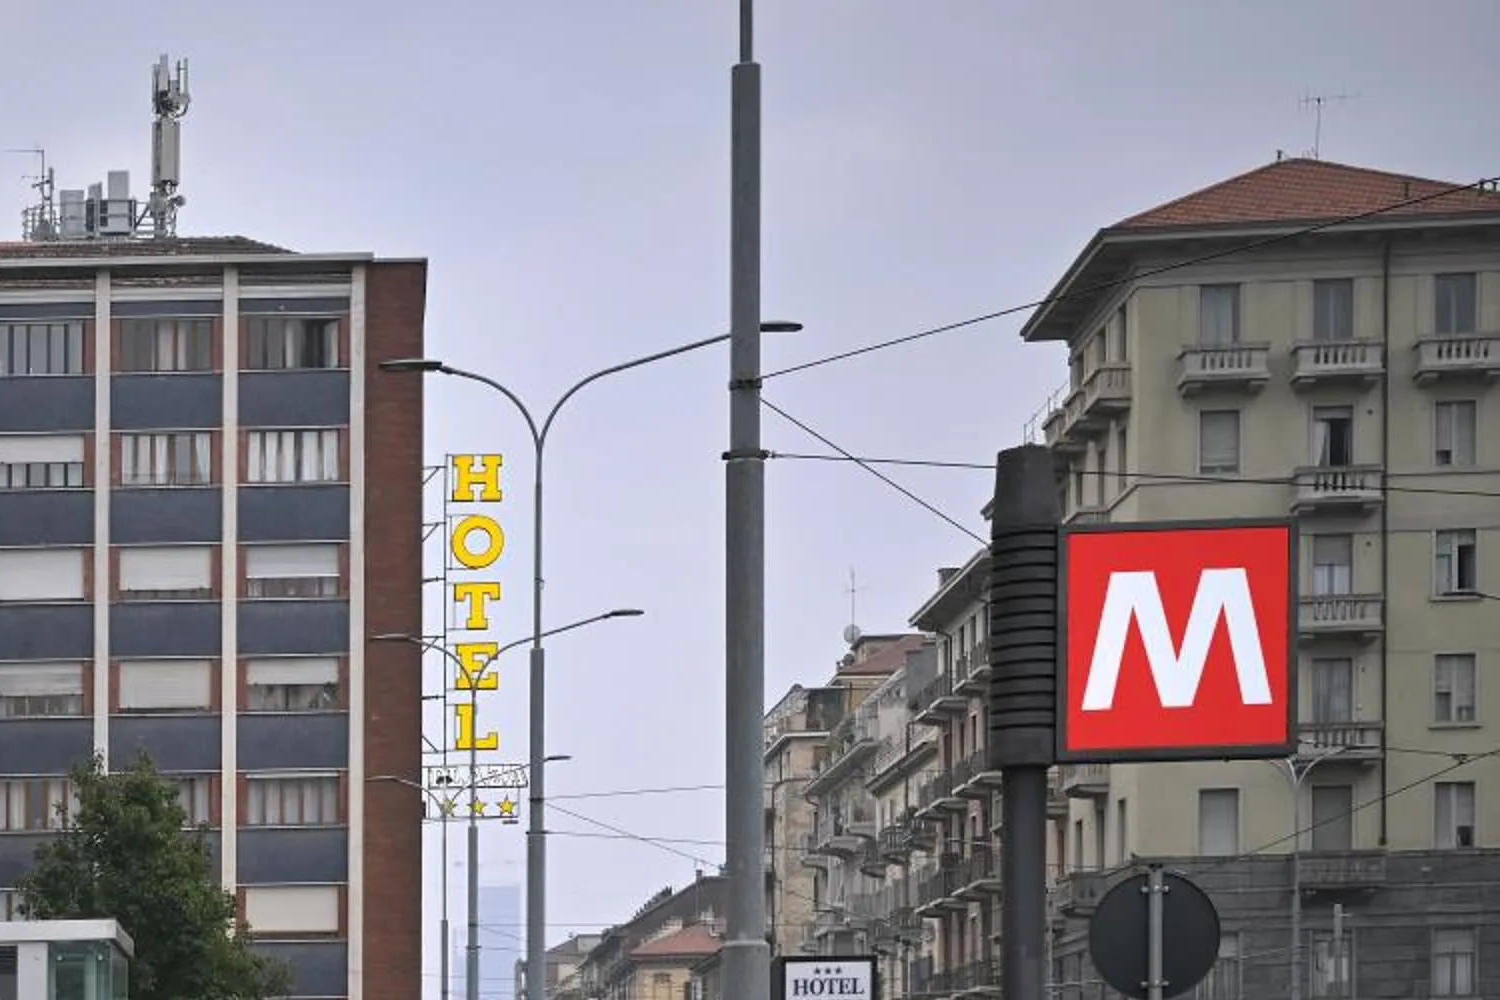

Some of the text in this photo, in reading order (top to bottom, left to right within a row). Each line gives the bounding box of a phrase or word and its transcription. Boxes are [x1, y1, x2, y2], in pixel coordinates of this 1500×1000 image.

[452, 454, 504, 750] HOTEL
[1081, 567, 1273, 711] M
[793, 978, 864, 996] HOTEL
